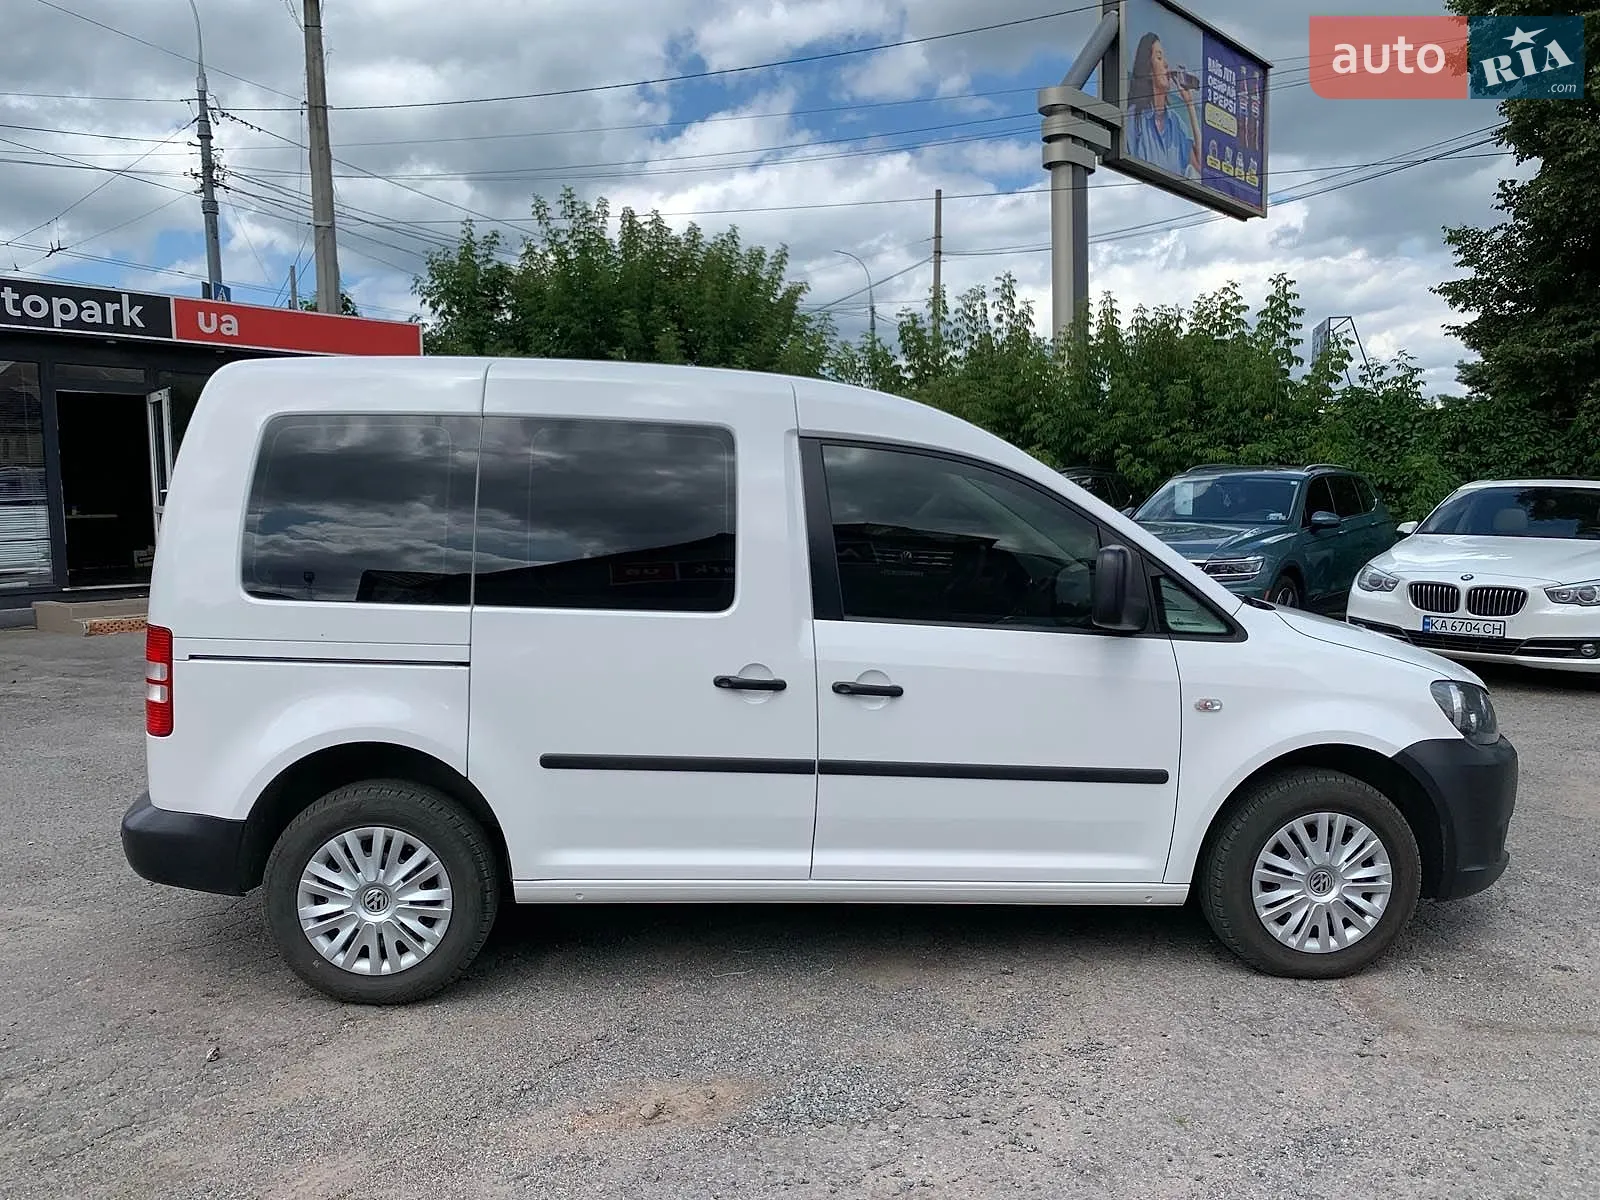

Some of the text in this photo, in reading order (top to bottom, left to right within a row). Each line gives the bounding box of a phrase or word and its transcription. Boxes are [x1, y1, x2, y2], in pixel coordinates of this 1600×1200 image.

[0, 286, 146, 328] topark
[197, 311, 239, 337] ua
[1430, 619, 1448, 631] KA
[1450, 620, 1480, 633] 6704
[1482, 623, 1502, 635] CH
